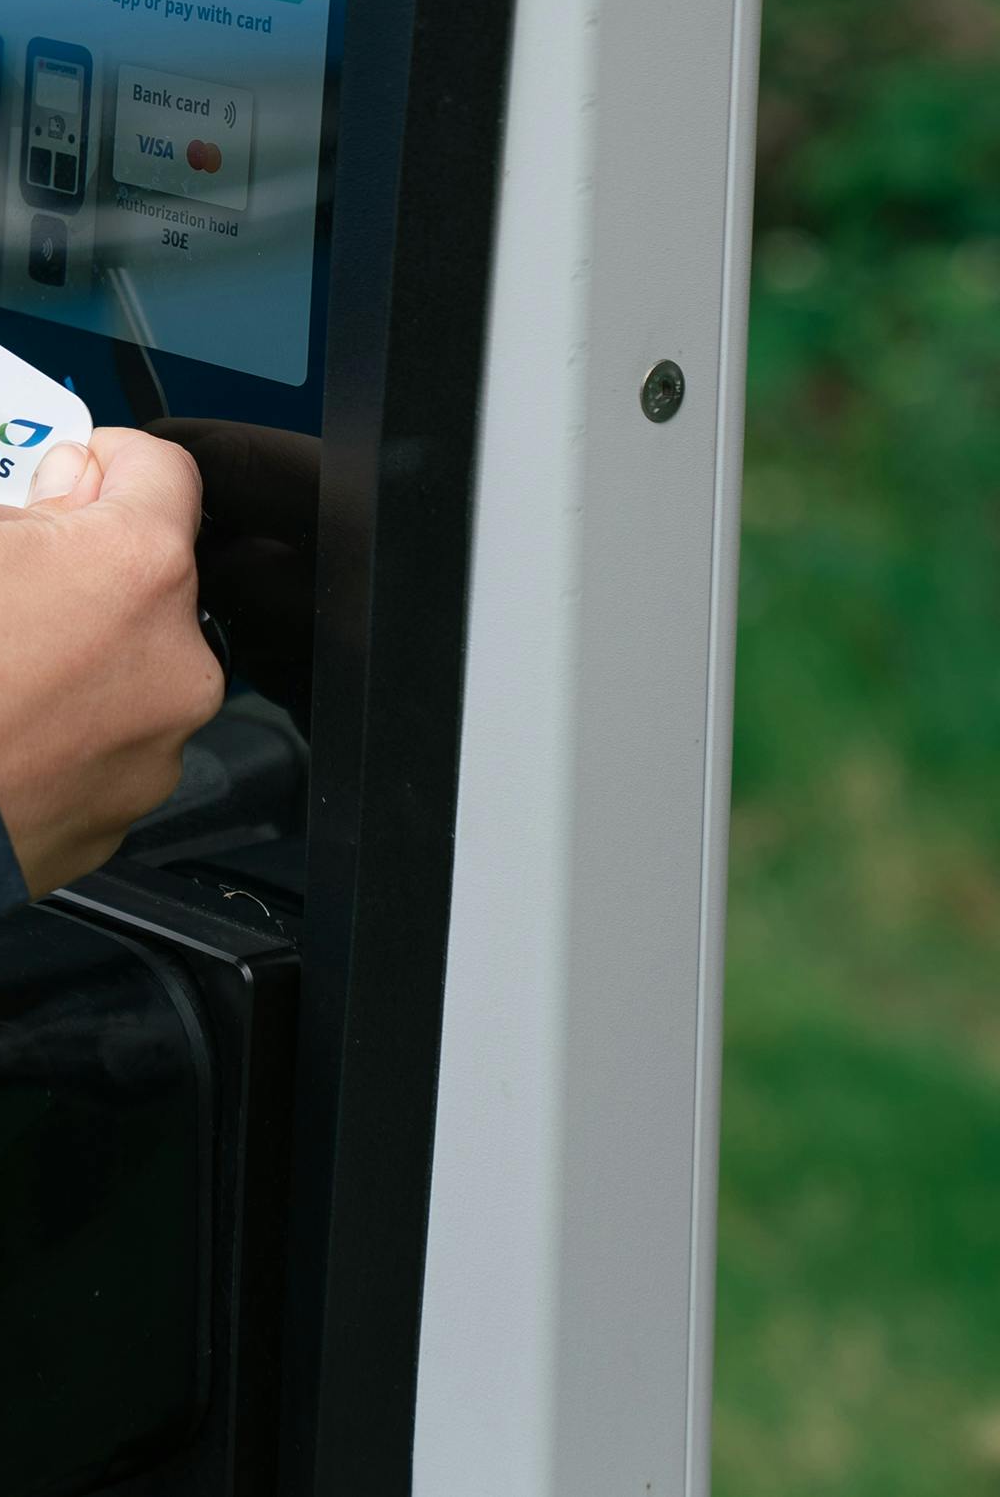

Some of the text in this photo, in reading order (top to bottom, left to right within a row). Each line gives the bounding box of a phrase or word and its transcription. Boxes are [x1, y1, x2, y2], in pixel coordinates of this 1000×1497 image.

[196, 3, 233, 27] with
[236, 13, 273, 35] card
[132, 83, 211, 117] Bank card
[136, 133, 175, 160] VISA
[116, 195, 239, 238] Authorization hold
[161, 227, 190, 251] 30£
